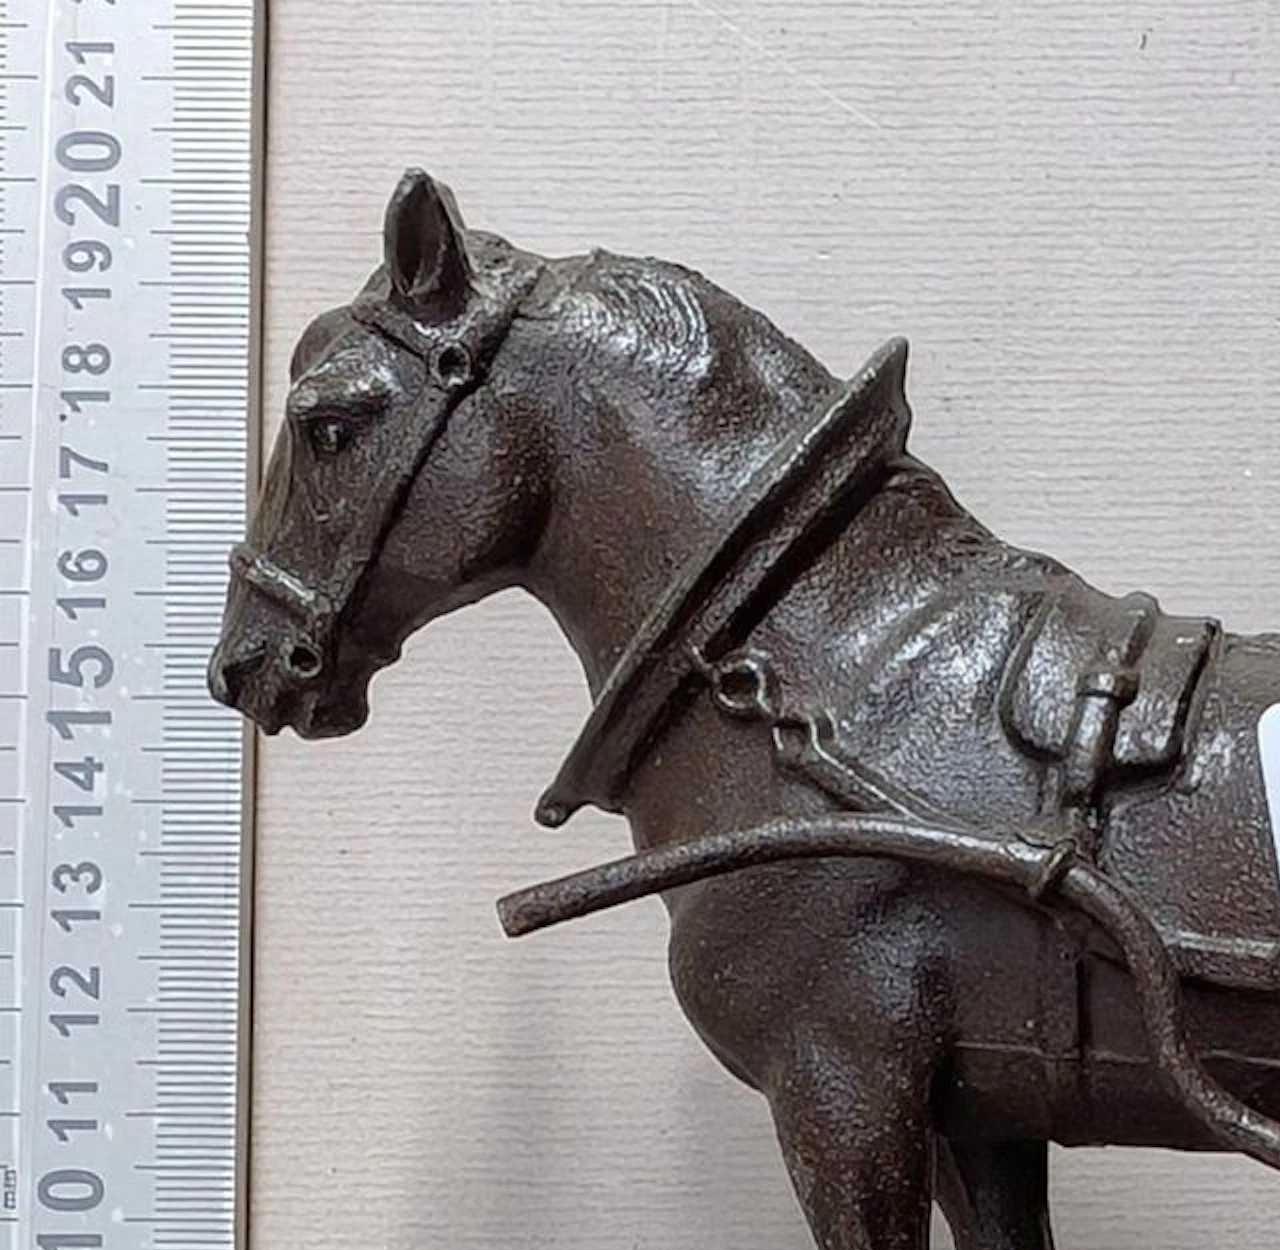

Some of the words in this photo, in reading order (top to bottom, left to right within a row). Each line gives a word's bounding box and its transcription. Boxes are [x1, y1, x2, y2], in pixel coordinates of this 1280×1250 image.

[64, 42, 115, 108] 21
[54, 131, 122, 227] 20
[61, 241, 112, 310] 19
[60, 344, 111, 413] 18
[58, 446, 109, 517] 17
[56, 549, 108, 620] 16
[45, 646, 114, 740] 15
[53, 756, 104, 828] 14
[50, 862, 102, 933] 13
[49, 966, 100, 1037] 12
[47, 1082, 98, 1142] 11
